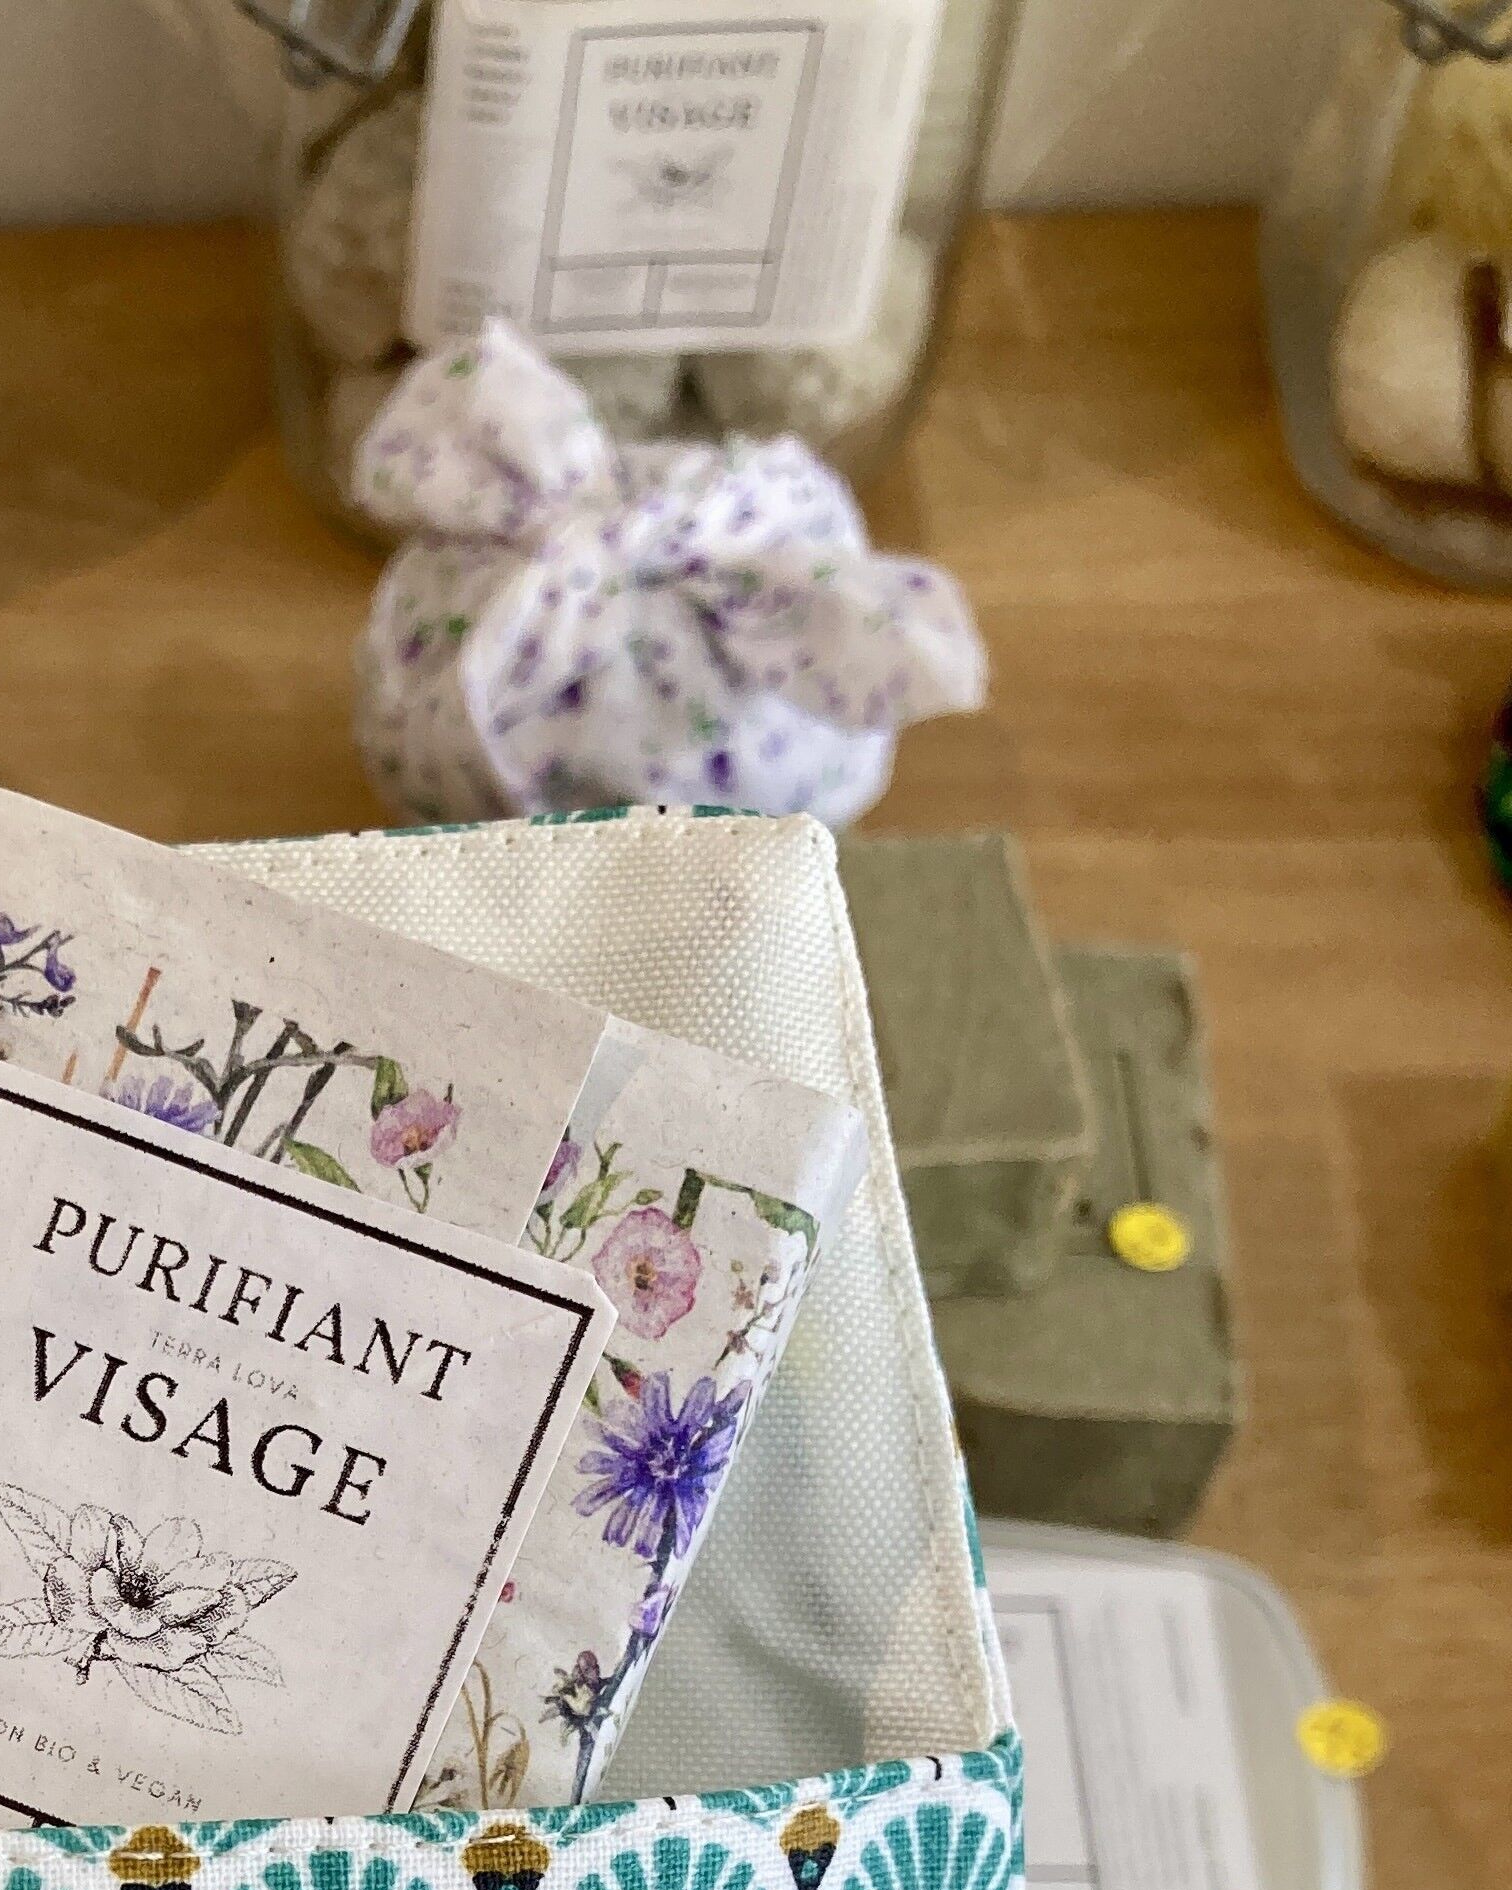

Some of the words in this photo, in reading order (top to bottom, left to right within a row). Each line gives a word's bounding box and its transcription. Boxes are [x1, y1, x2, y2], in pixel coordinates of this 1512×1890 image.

[33, 1196, 472, 1401] PURIFIANT
[150, 1328, 221, 1375] TERRA
[232, 1361, 300, 1401] LOVA
[33, 1326, 387, 1525] VISAGE
[35, 1734, 77, 1763] BIO
[87, 1755, 101, 1776] &
[117, 1763, 202, 1813] VEGAN
